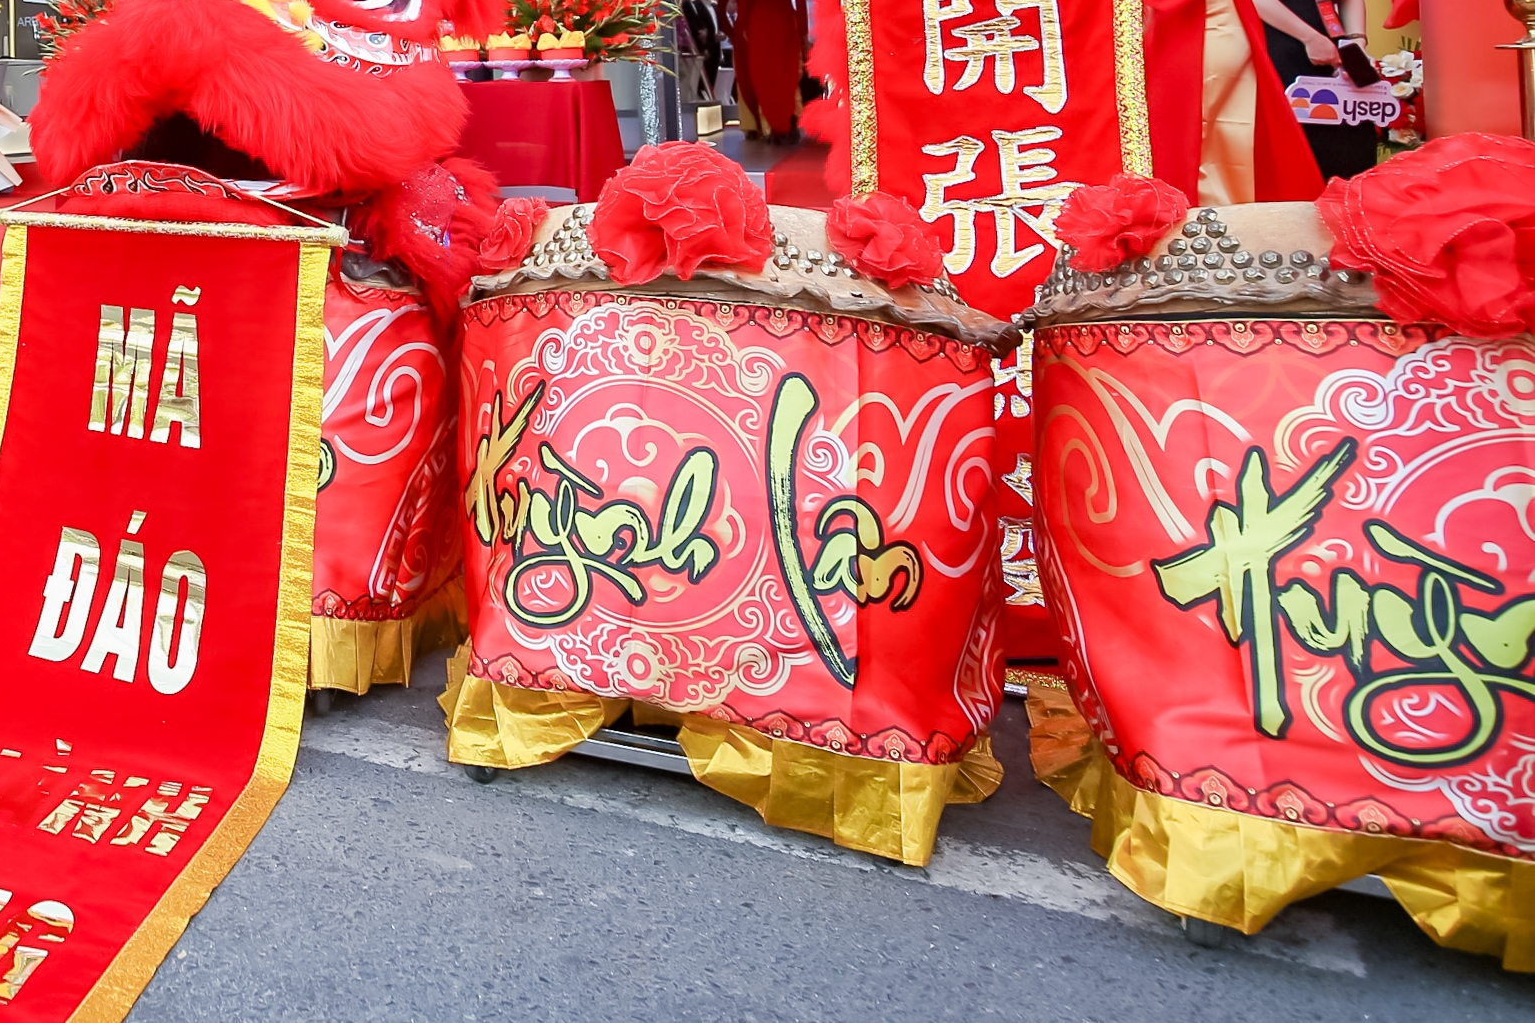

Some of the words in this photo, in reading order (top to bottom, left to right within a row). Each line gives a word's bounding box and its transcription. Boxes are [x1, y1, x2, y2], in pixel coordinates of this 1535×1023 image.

[1342, 99, 1397, 123] dash
[87, 284, 203, 450] MÃ
[27, 510, 208, 696] ĐÁO
